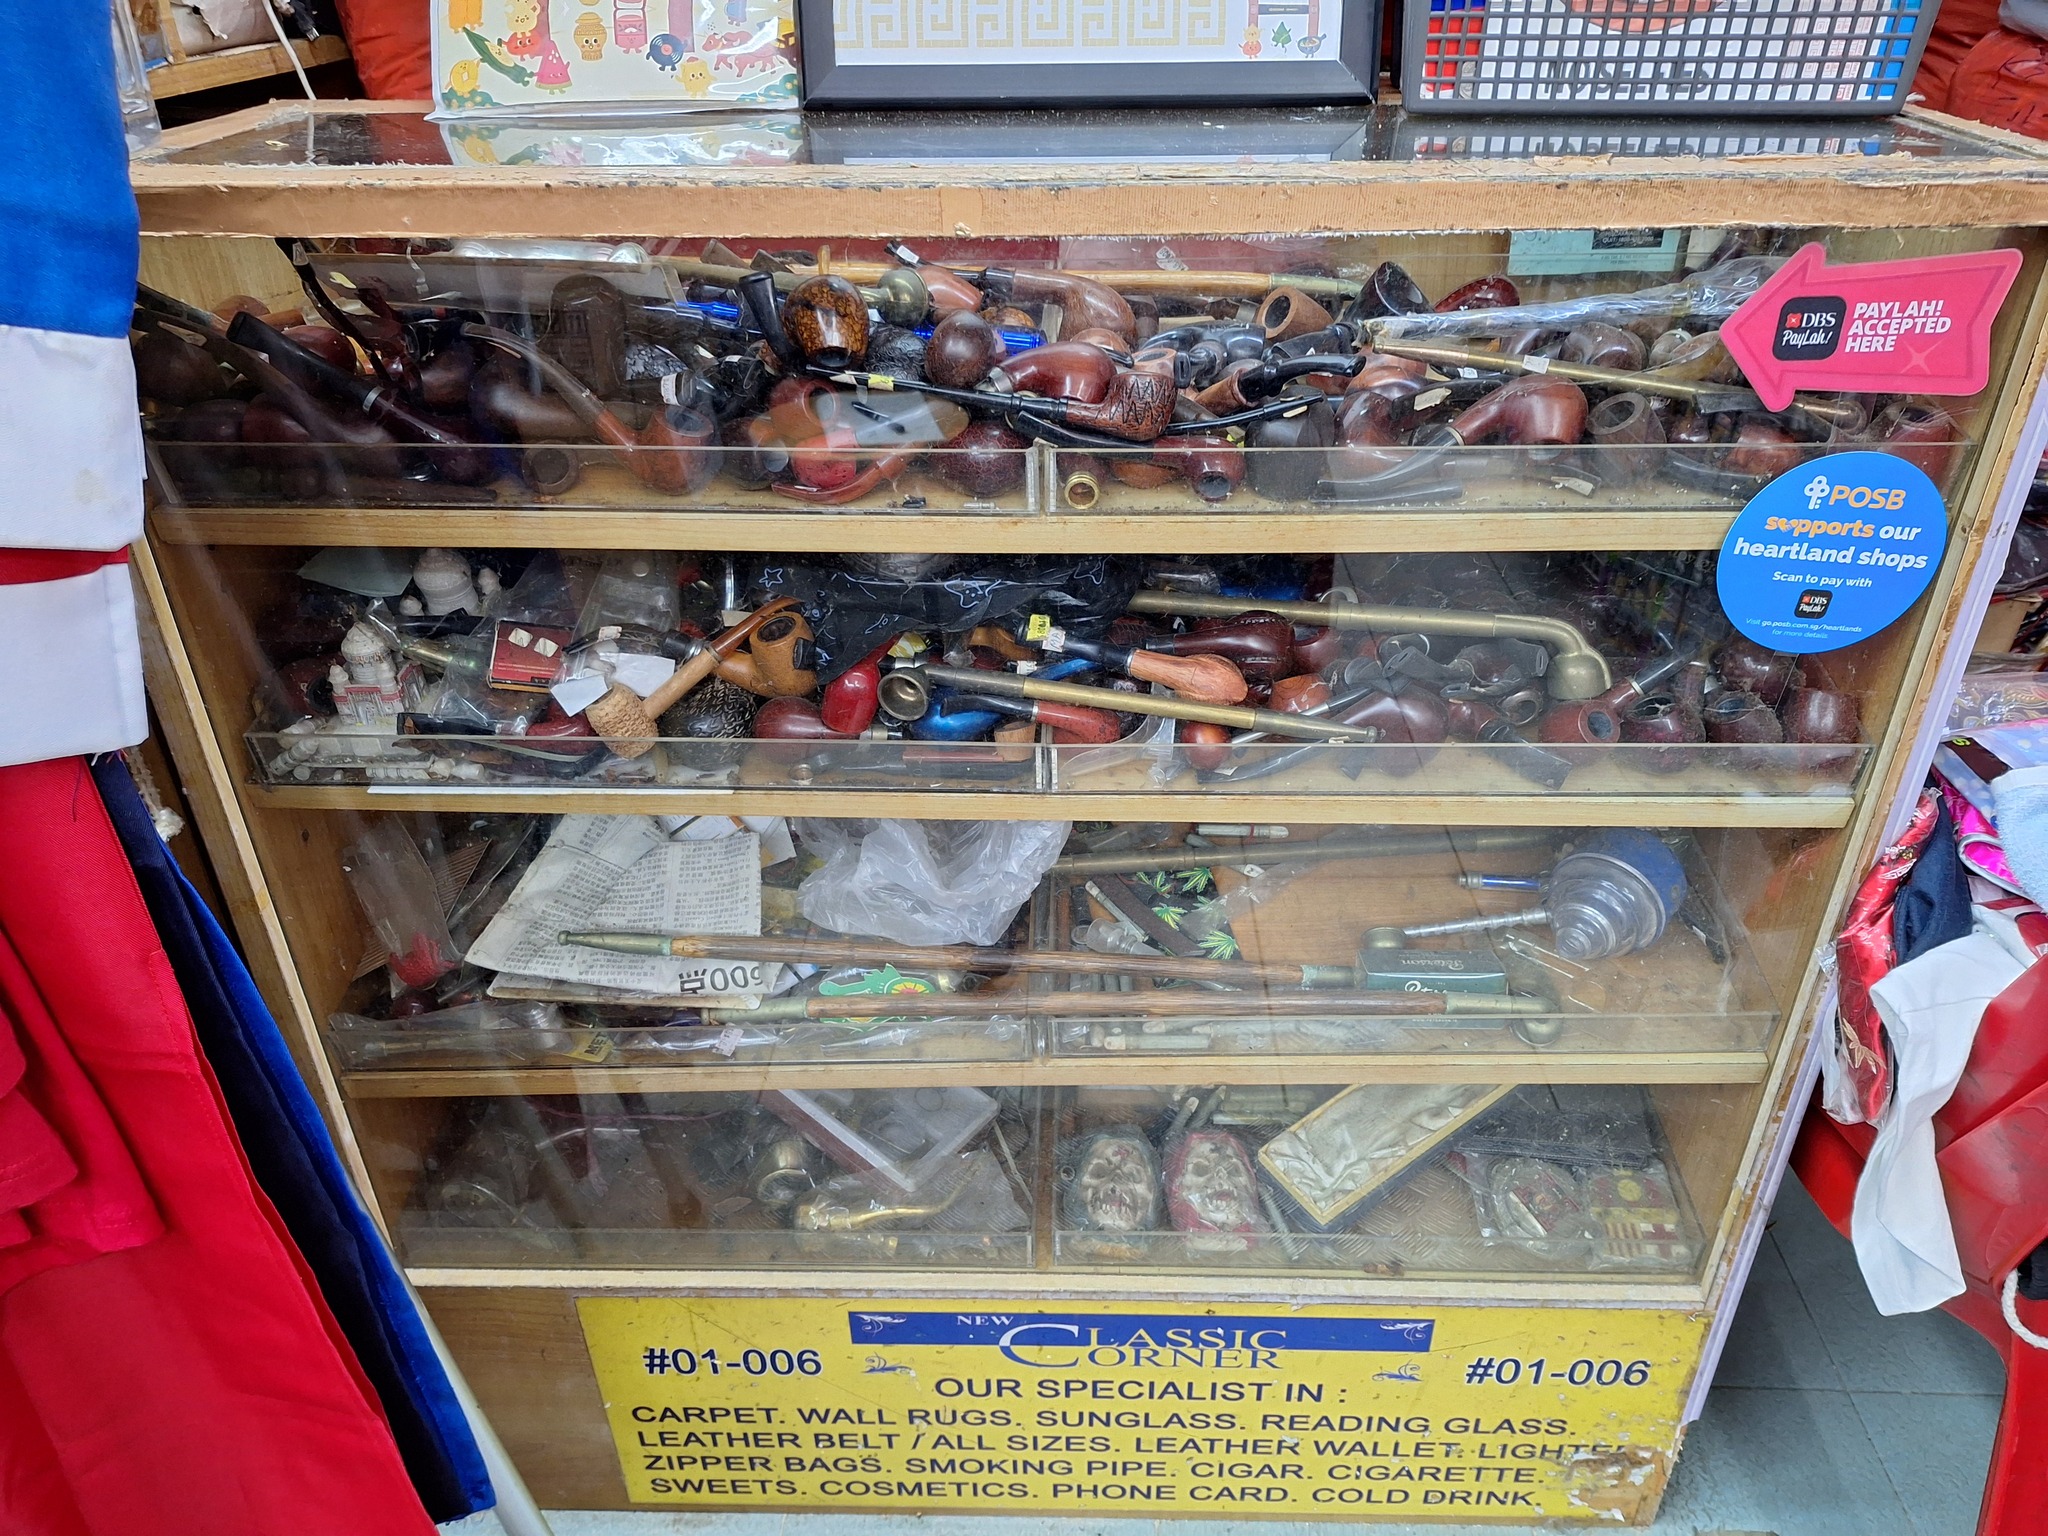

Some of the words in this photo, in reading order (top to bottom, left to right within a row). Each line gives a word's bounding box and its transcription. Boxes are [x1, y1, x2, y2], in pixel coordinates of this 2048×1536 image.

[1801, 312, 1836, 328] DBS
[1853, 300, 1943, 319] PAYLAH!
[1847, 317, 1951, 336] ACCEPTED
[1781, 329, 1833, 349] PayLah!
[1844, 335, 1897, 353] HERE
[1828, 485, 1906, 510] POSB
[1879, 524, 1922, 541] our
[1733, 537, 1855, 564] heartland
[1856, 547, 1929, 572] shops
[1772, 571, 1803, 583] Scan
[1805, 574, 1818, 584] to
[1820, 576, 1844, 588] pay
[1846, 577, 1873, 588] with
[1810, 596, 1828, 605] DBS
[1762, 620, 1862, 633] go.posb.com.sg/heartlands
[957, 1315, 1014, 1327] NEW
[999, 1323, 1288, 1367] CLASSIC
[643, 1347, 824, 1376] #01-006
[1464, 1356, 1652, 1387] #01-006
[935, 1378, 1023, 1398] OUR
[1037, 1379, 1273, 1402] SPECIALIST
[1284, 1382, 1323, 1403] IN
[631, 1405, 786, 1425] CARPET.
[797, 1408, 897, 1426] WALL
[908, 1408, 1023, 1428] RUGS.
[1036, 1410, 1247, 1431] SUNGLASS.
[1261, 1414, 1430, 1435] READING
[1443, 1416, 1576, 1436] GLASS.
[637, 1431, 801, 1449] LEATHER
[812, 1432, 901, 1450] BELT
[1006, 1435, 1120, 1453] SIZES.
[1135, 1437, 1301, 1456] LEATHER
[1314, 1440, 1462, 1459] WALLET.
[644, 1454, 772, 1473] ZIPPER
[784, 1455, 893, 1475] BAGS.
[905, 1456, 1073, 1477] SMOKING
[1086, 1458, 1174, 1479] PIPE.
[1190, 1461, 1313, 1481] CIGAR.
[1327, 1464, 1545, 1485] CIGARETTE.
[650, 1478, 807, 1497] SWEETS.
[819, 1479, 1038, 1499] COSMETICS.
[1052, 1482, 1177, 1502] PHONE
[1189, 1484, 1298, 1504] CARD.
[1312, 1485, 1409, 1505] COLD
[1422, 1487, 1543, 1508] DRINK.
